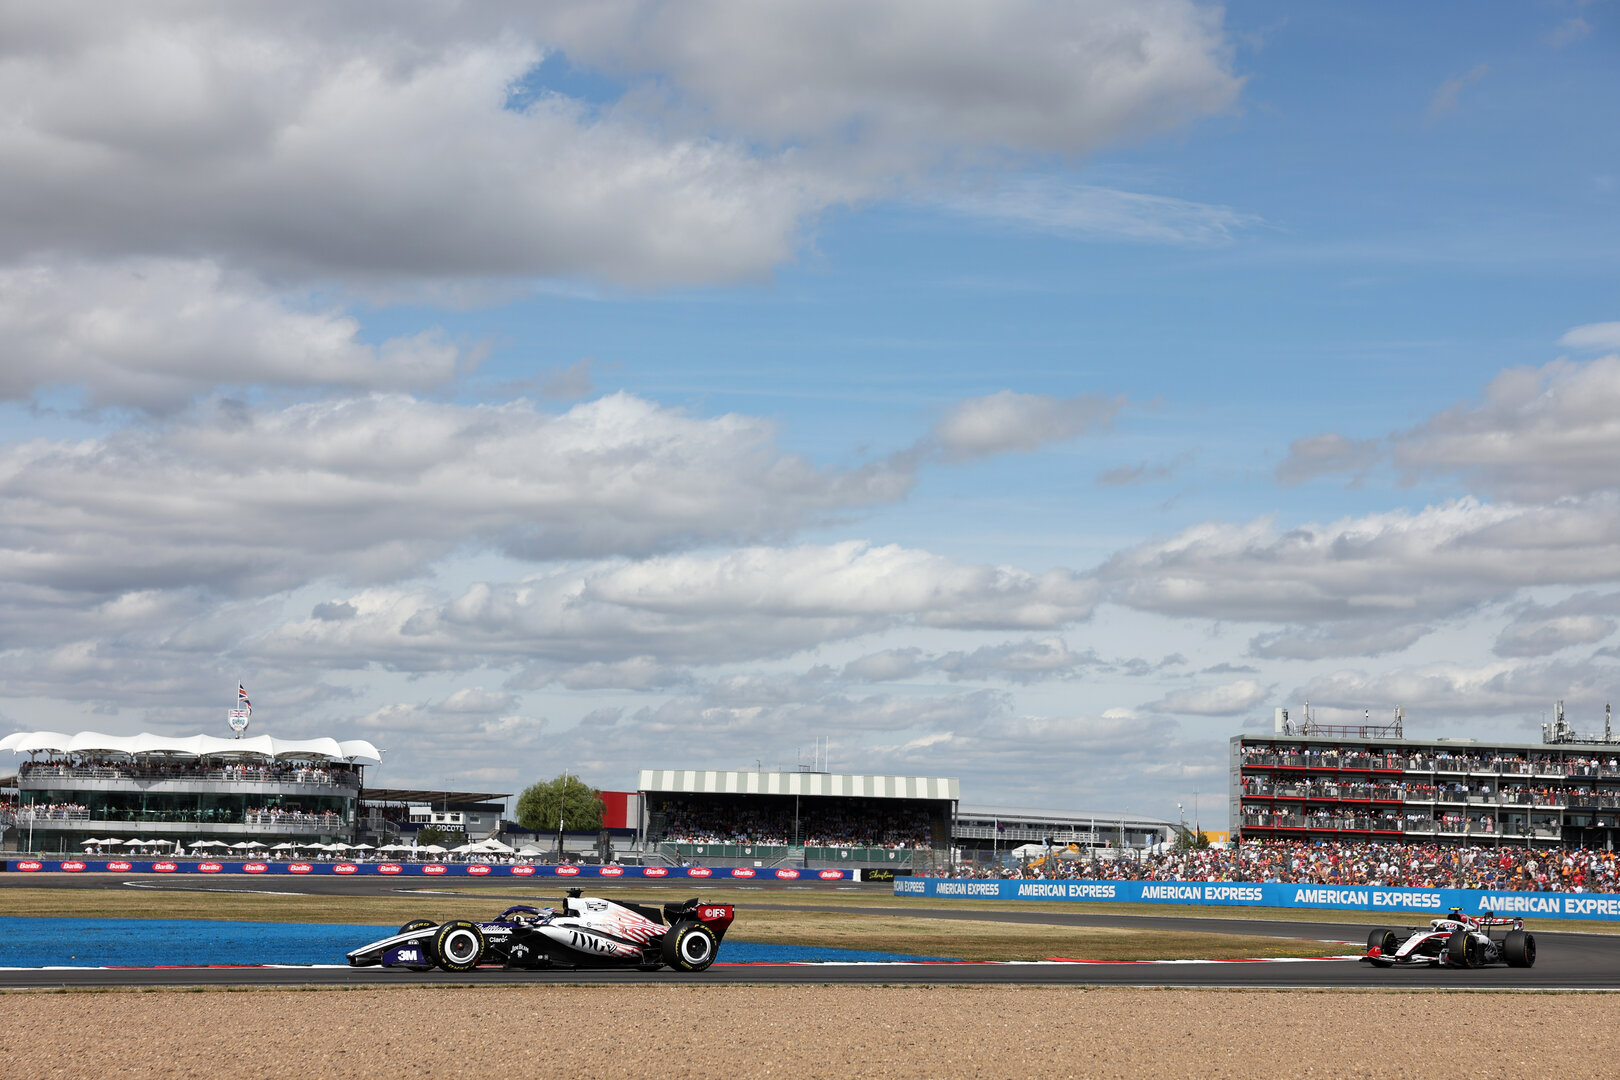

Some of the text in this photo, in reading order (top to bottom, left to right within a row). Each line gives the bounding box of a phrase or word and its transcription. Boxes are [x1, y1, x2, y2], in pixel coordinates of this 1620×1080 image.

[906, 881, 924, 893] EXPRESS
[936, 883, 999, 896] AMERICAN EXPRESS
[1018, 884, 1116, 898] AMERICAN EXPRESS
[1141, 886, 1263, 901] AMERICAN EXPRESS
[1295, 889, 1441, 908] AMERICAN EXPRESS
[1479, 896, 1560, 913] AMERICAN
[397, 950, 418, 961] 3M
